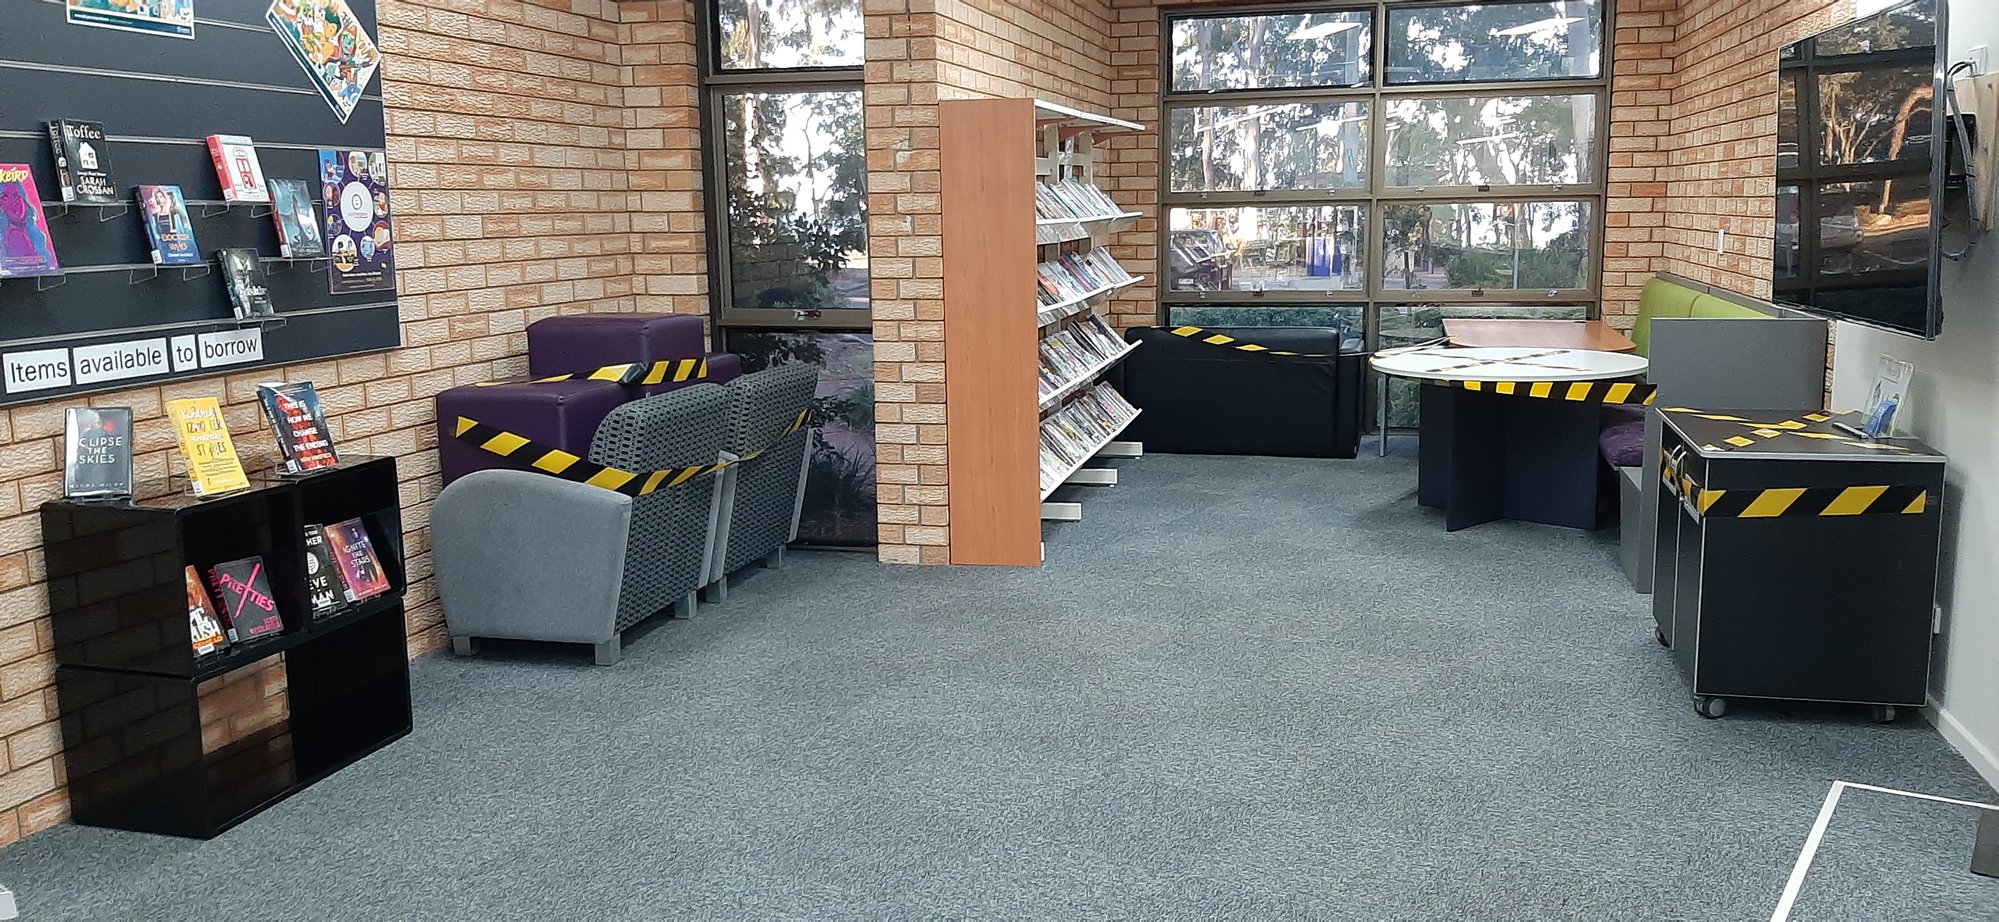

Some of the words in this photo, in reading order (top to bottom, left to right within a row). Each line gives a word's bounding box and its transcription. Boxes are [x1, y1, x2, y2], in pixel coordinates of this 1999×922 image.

[66, 125, 101, 139] Toffee
[77, 185, 114, 195] CROSSAN
[10, 362, 68, 383] Items
[80, 347, 162, 375] available
[176, 346, 194, 363] to
[204, 337, 257, 359] borrow
[79, 454, 116, 464] SKIES
